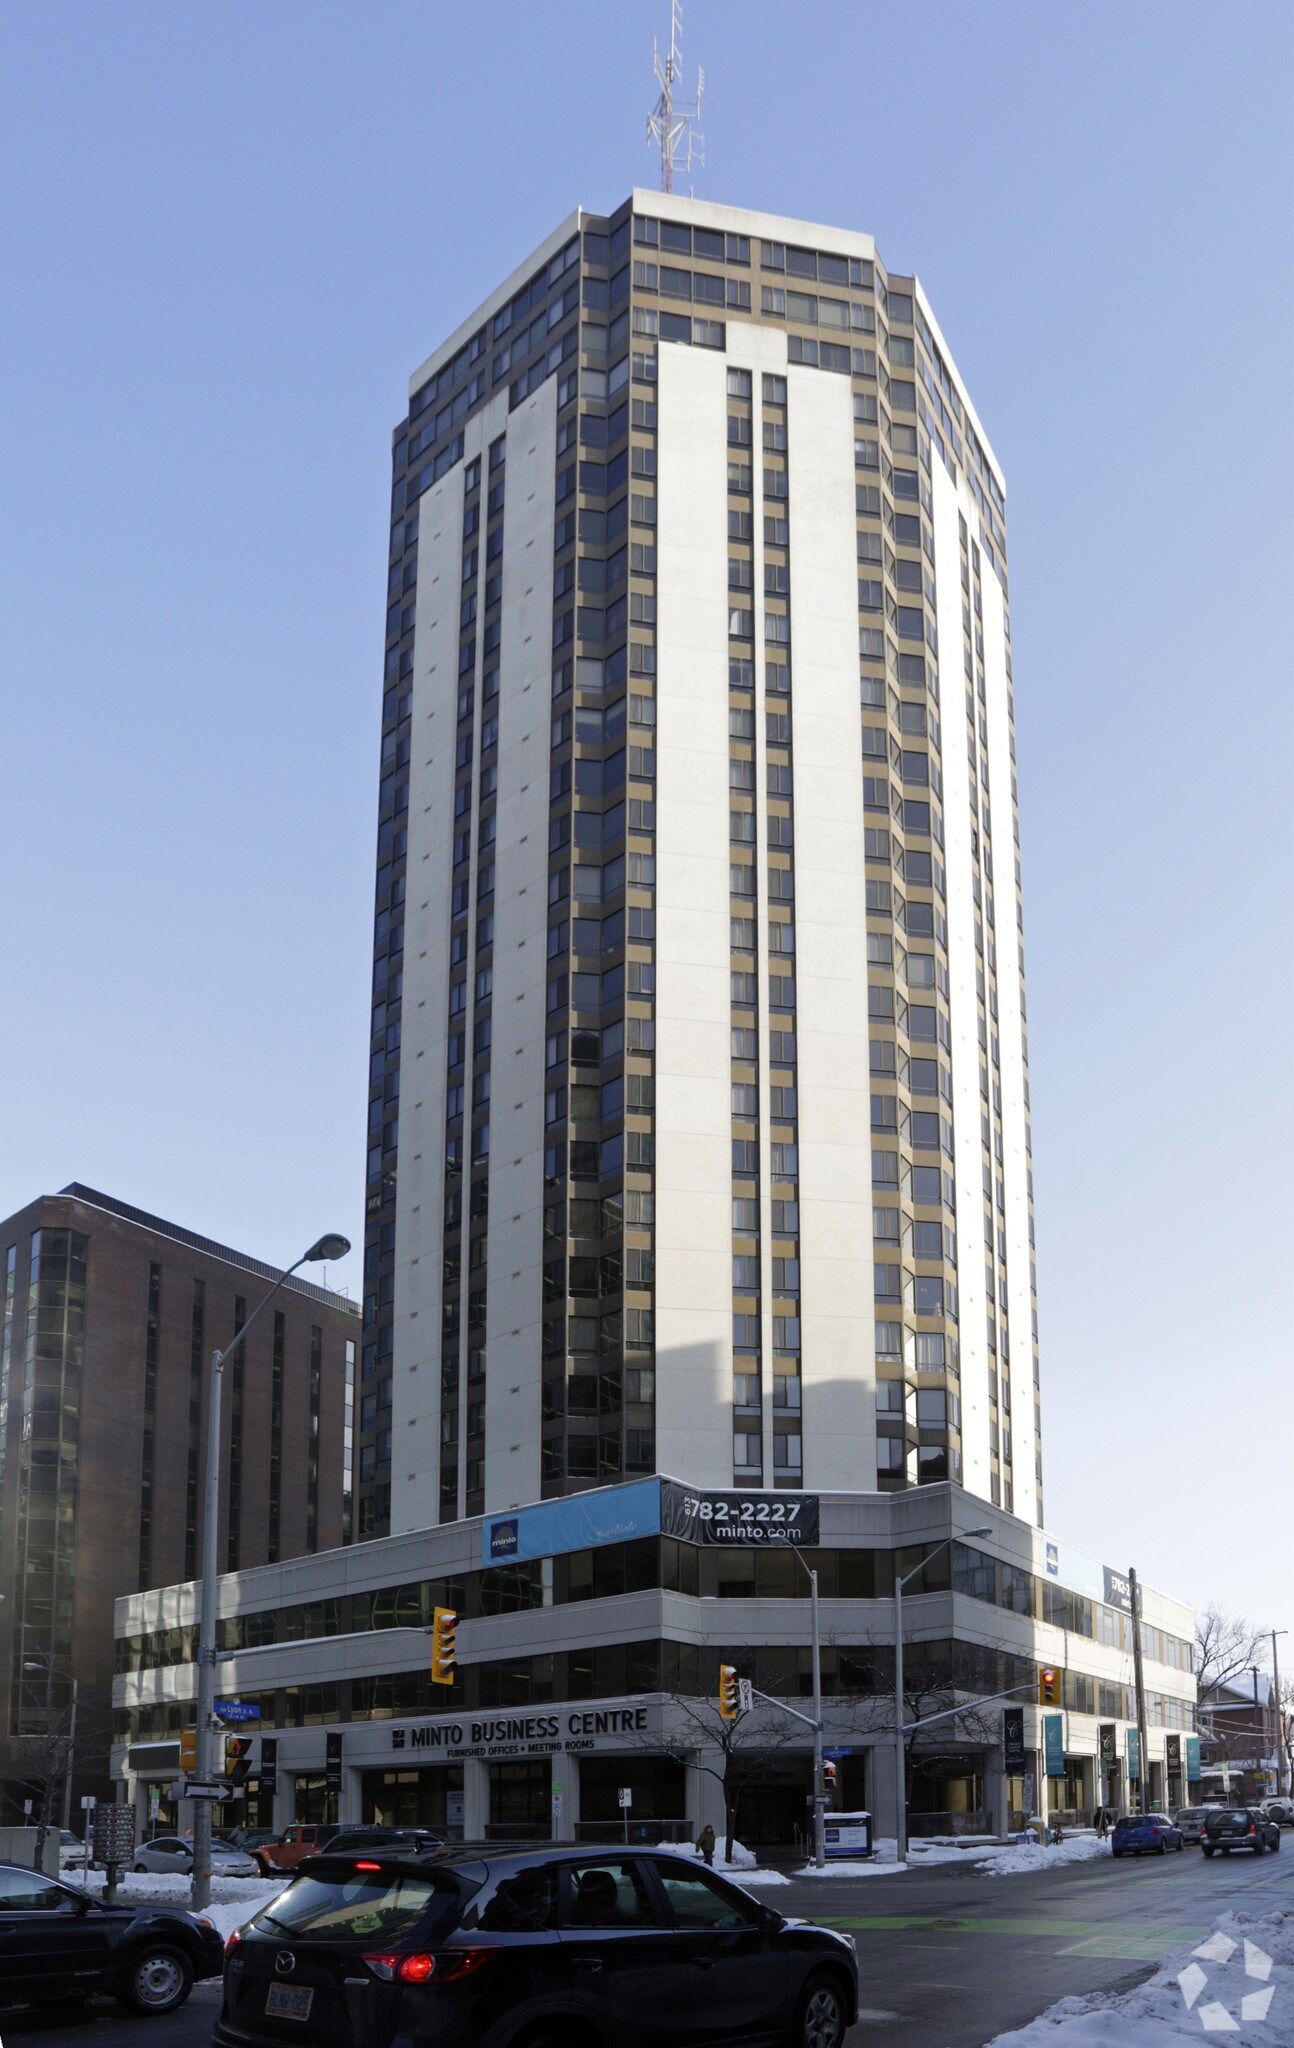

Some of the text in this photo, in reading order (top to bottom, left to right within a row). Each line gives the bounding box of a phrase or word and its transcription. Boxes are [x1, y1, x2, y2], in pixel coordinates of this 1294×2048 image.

[691, 1499, 800, 1521] 782-2227
[716, 1525, 800, 1538] minto.com
[492, 1536, 516, 1547] minto
[227, 1705, 242, 1715] Lyon
[412, 1707, 648, 1748] MINTO BUSINESS CENTRE
[447, 1739, 595, 1758] FURNISHED OFFICES MEETING ROOMS
